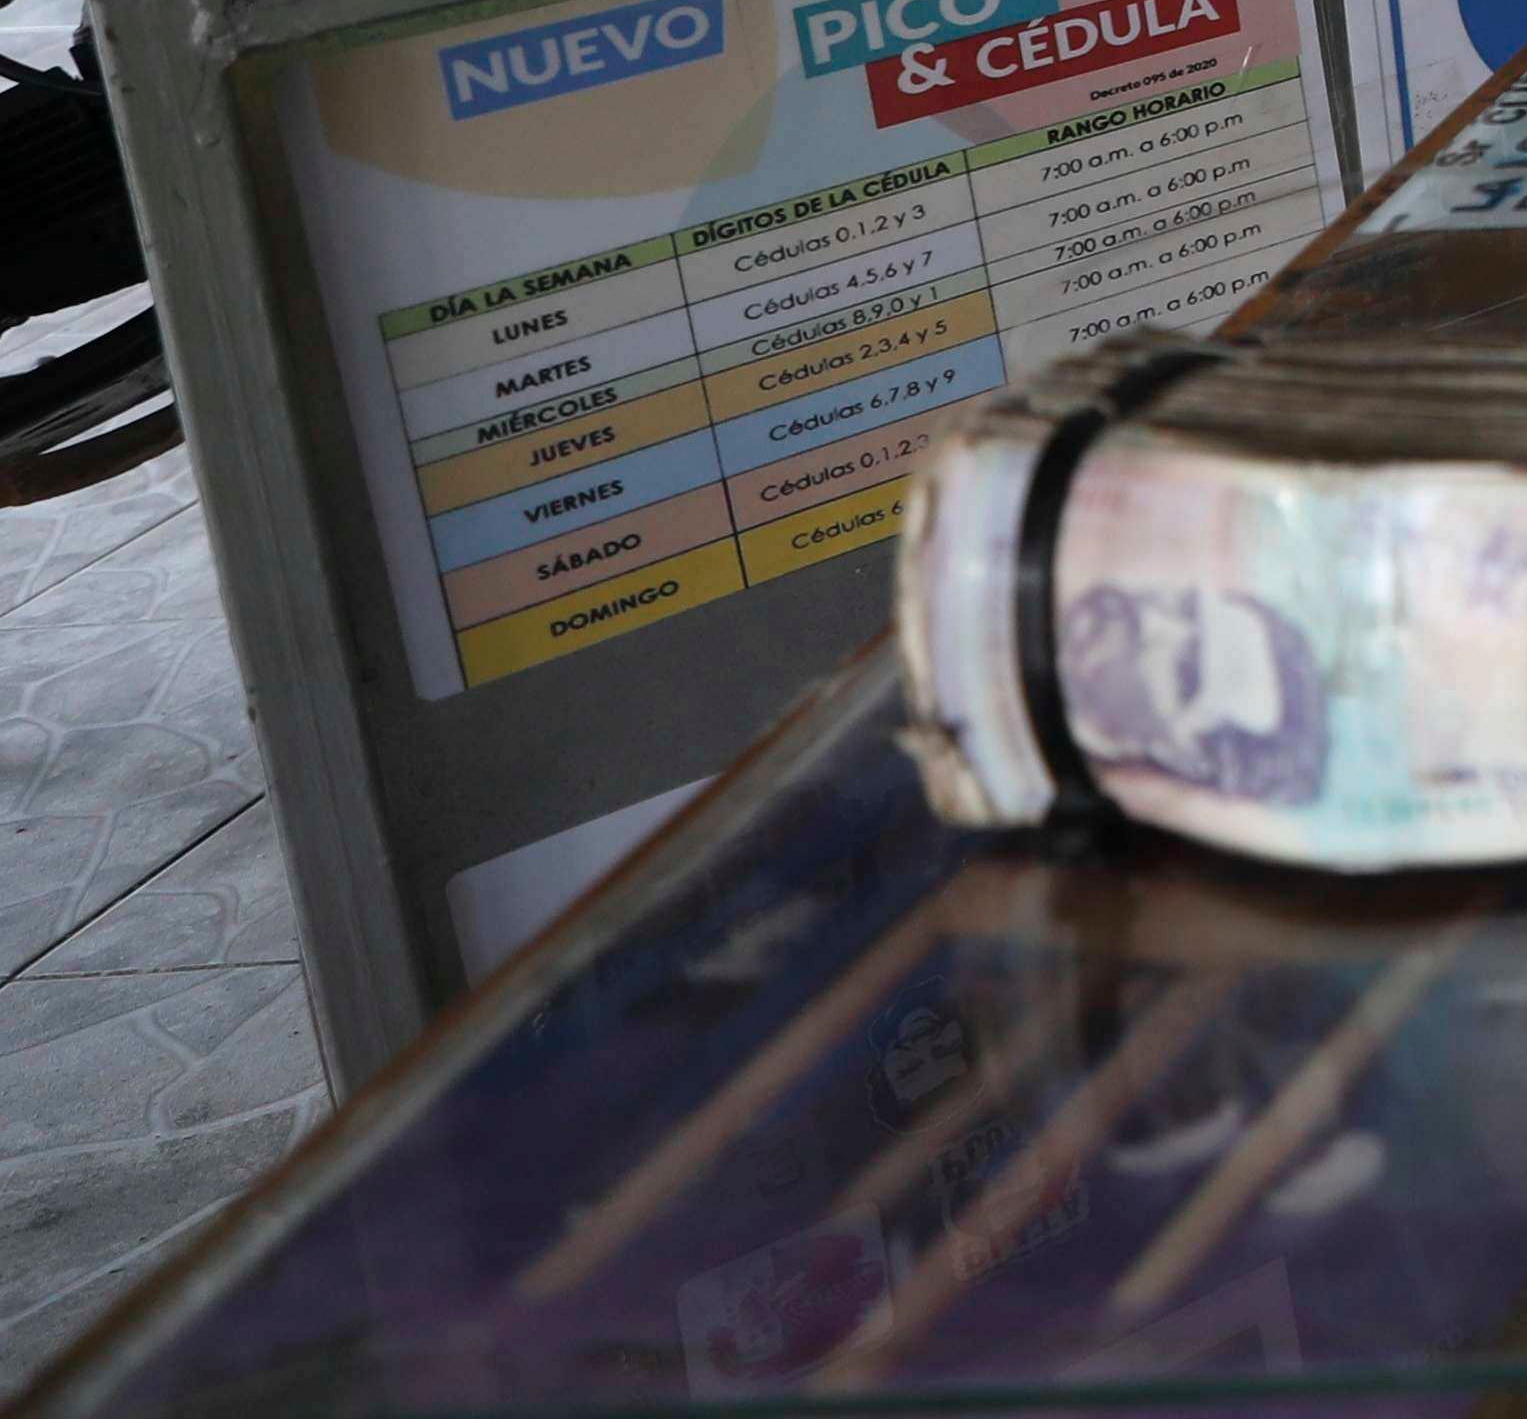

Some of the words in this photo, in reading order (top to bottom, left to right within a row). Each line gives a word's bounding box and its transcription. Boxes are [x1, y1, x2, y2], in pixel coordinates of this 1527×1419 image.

[453, 6, 711, 103] NUEVO
[897, 42, 955, 95] &
[1046, 111, 1127, 144] RANGO
[1133, 82, 1226, 121] HORARIO
[693, 207, 787, 247] DÍGITOS
[794, 196, 824, 219] DE
[828, 187, 858, 208] LA
[863, 160, 951, 198] CÉDULA
[430, 296, 477, 324] DÍA
[484, 286, 517, 309] LA
[524, 253, 633, 296] SEMANA
[492, 310, 569, 345] LUNES
[496, 356, 592, 398] MARTES
[477, 387, 618, 445] MIÉRCOLES
[529, 426, 616, 468] JUEVES
[523, 480, 626, 524] VIERNES
[536, 534, 642, 581] SÁBADO
[550, 580, 680, 638] DOMINGO
